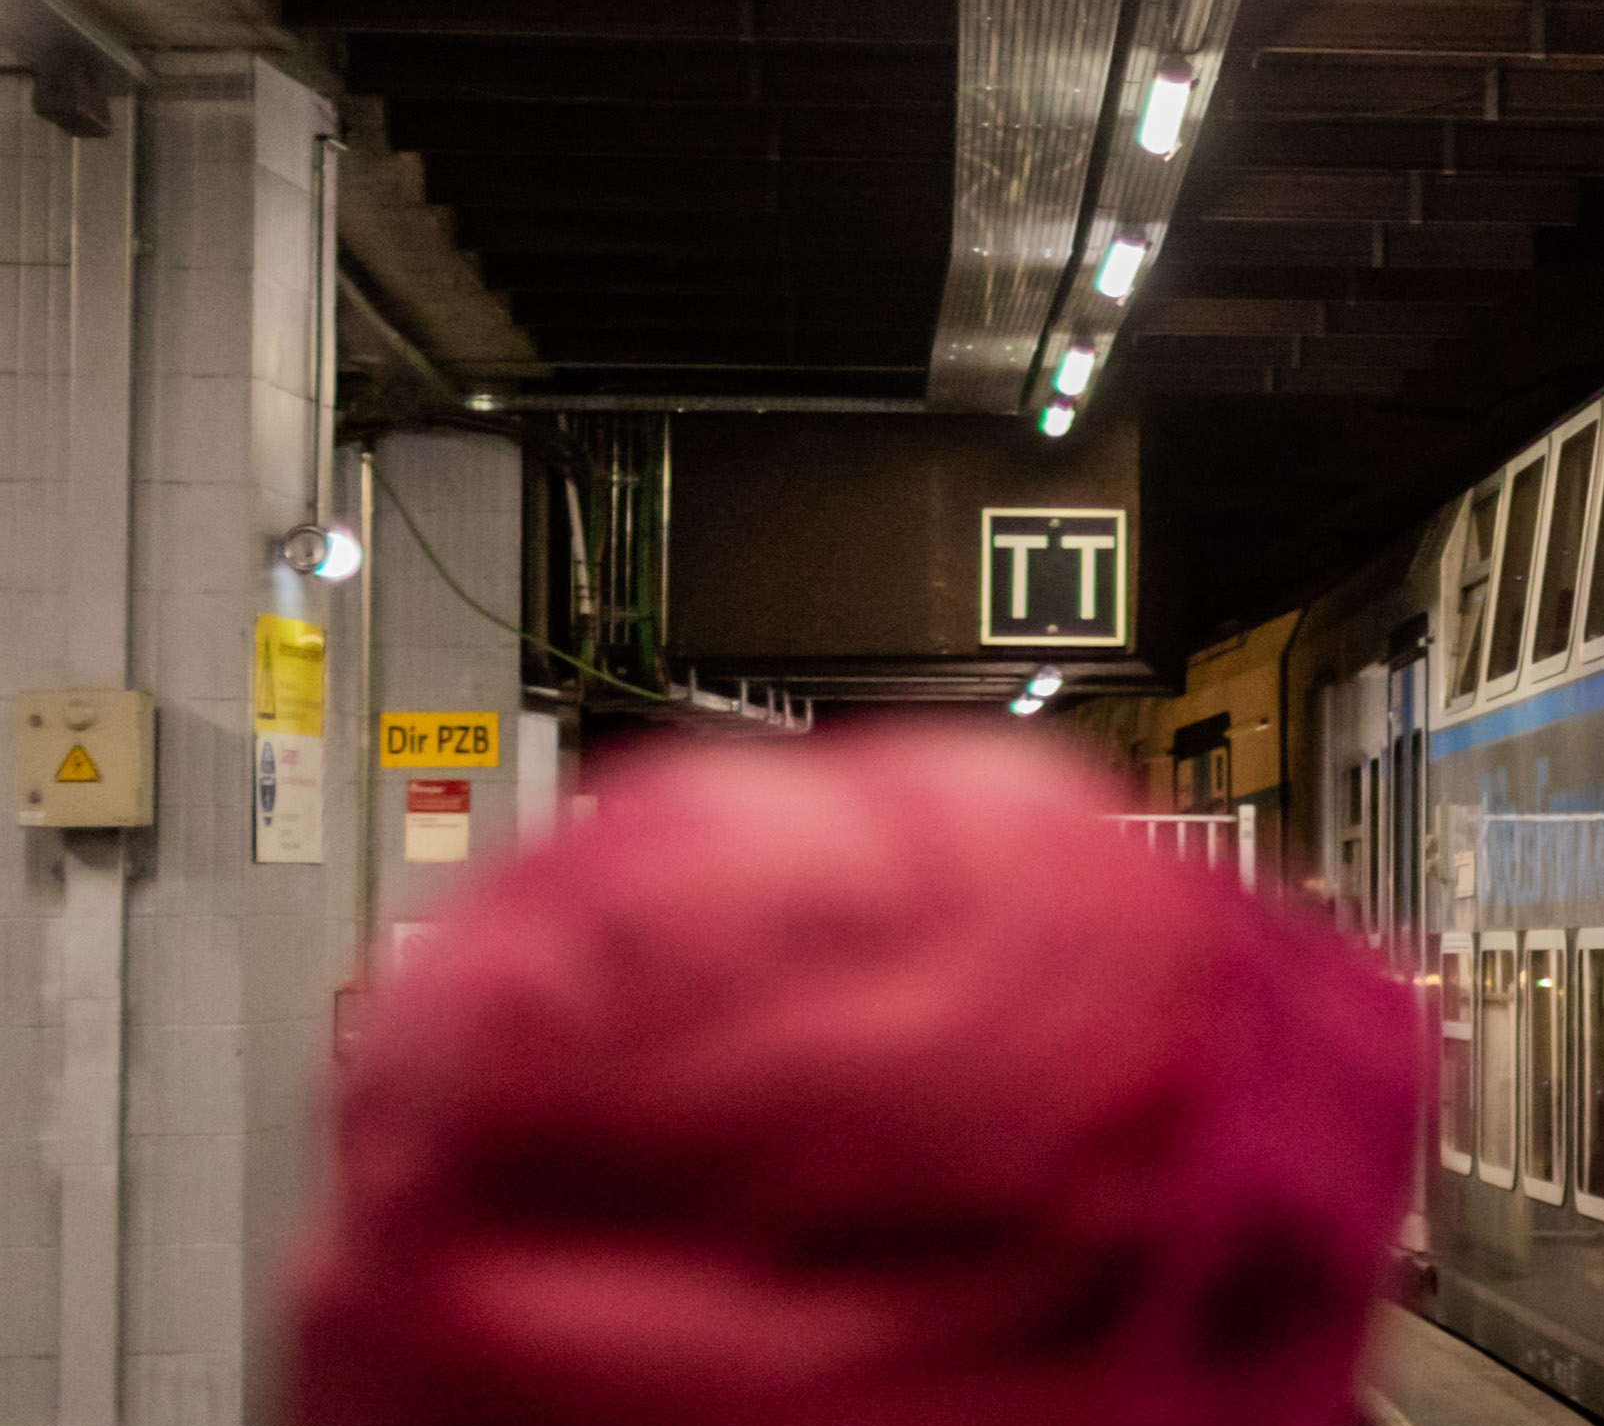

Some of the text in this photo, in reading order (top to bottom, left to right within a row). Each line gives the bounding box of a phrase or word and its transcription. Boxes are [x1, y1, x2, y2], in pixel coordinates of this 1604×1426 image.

[993, 534, 1116, 620] TT
[387, 726, 489, 754] Dir PZB
